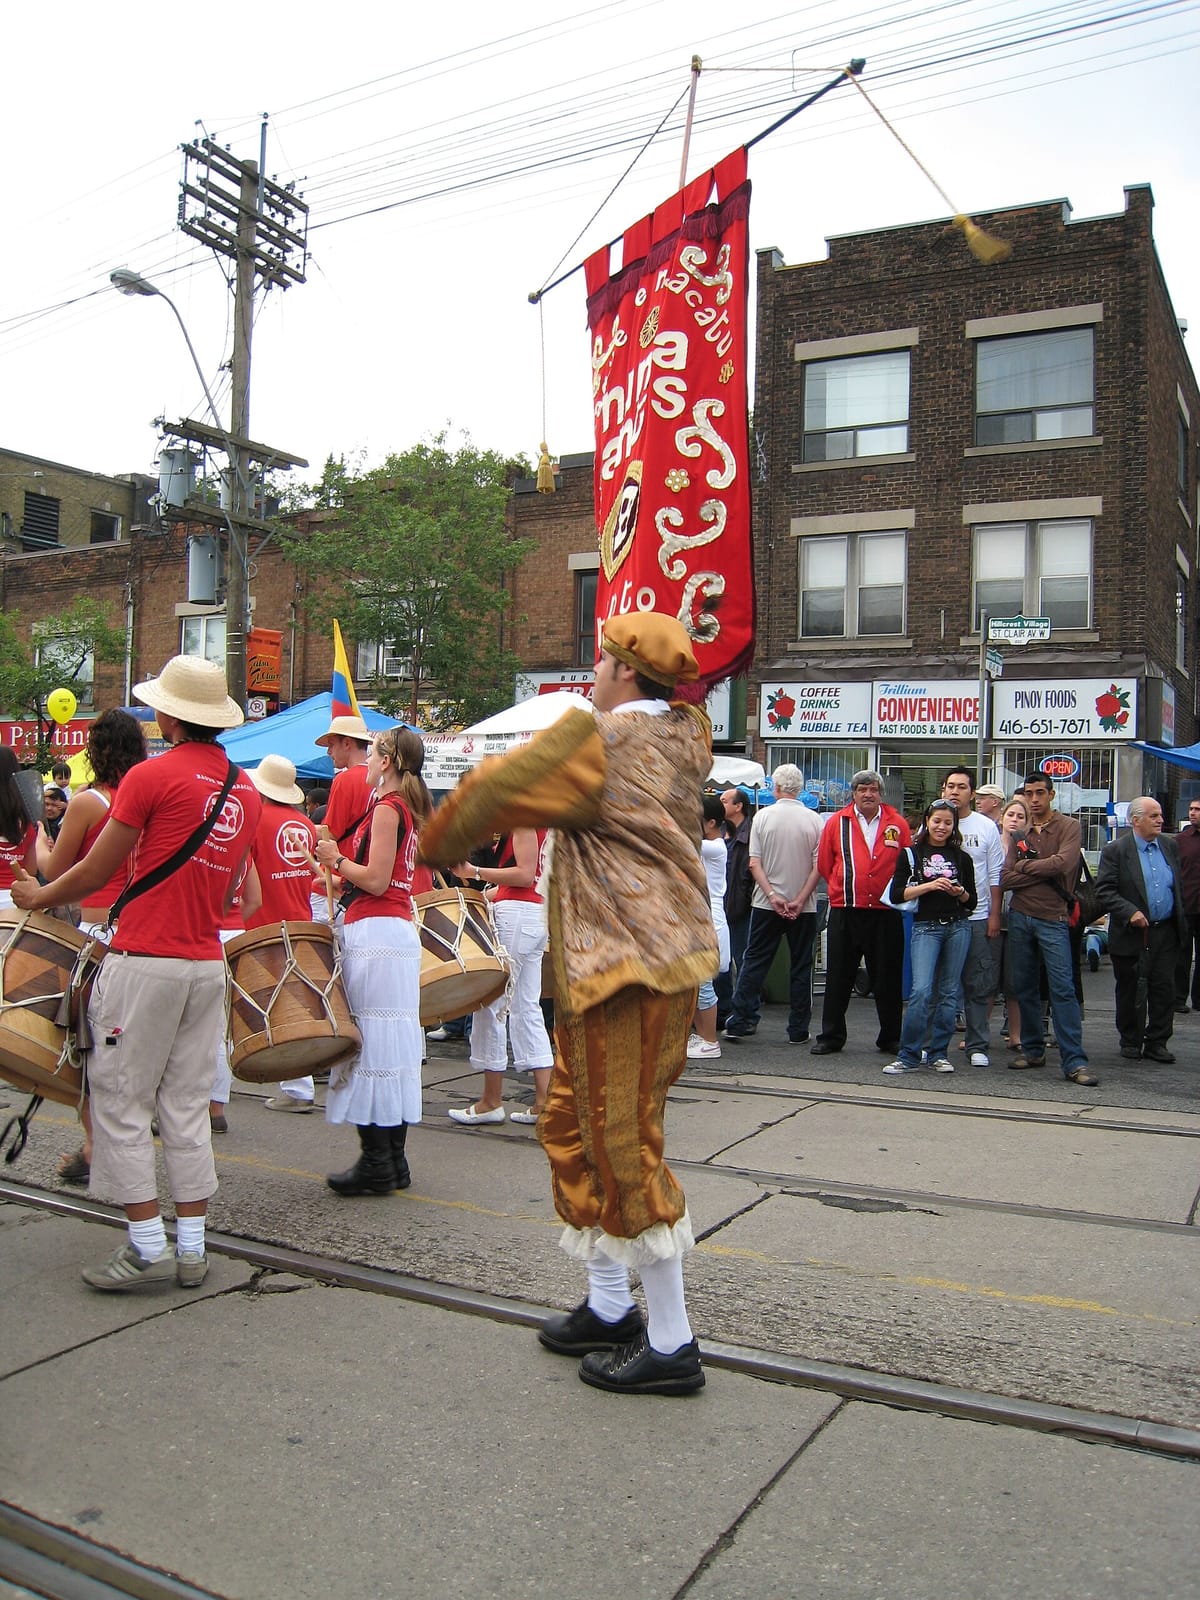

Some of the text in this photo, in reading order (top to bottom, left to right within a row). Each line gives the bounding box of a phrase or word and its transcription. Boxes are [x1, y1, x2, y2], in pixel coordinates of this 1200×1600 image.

[991, 620, 1048, 629] Hillcrest Village
[992, 629, 1001, 638] ST
[1003, 629, 1026, 638] CLAIR
[560, 674, 589, 682] BUD
[800, 687, 841, 698] COFFEE
[878, 683, 927, 695] Trillium
[799, 699, 841, 709] DRINKS
[1014, 689, 1077, 708] PINOY FOODS
[877, 697, 980, 722] CONVENIENCE
[800, 710, 828, 721] MILK
[799, 722, 868, 733] BUBBLE TEA
[879, 724, 979, 735] FAST FOODS & TAKE OUT
[999, 719, 1091, 735] 416-651-7871
[9, 724, 91, 747] Pritin
[1044, 760, 1073, 774] OPEN
